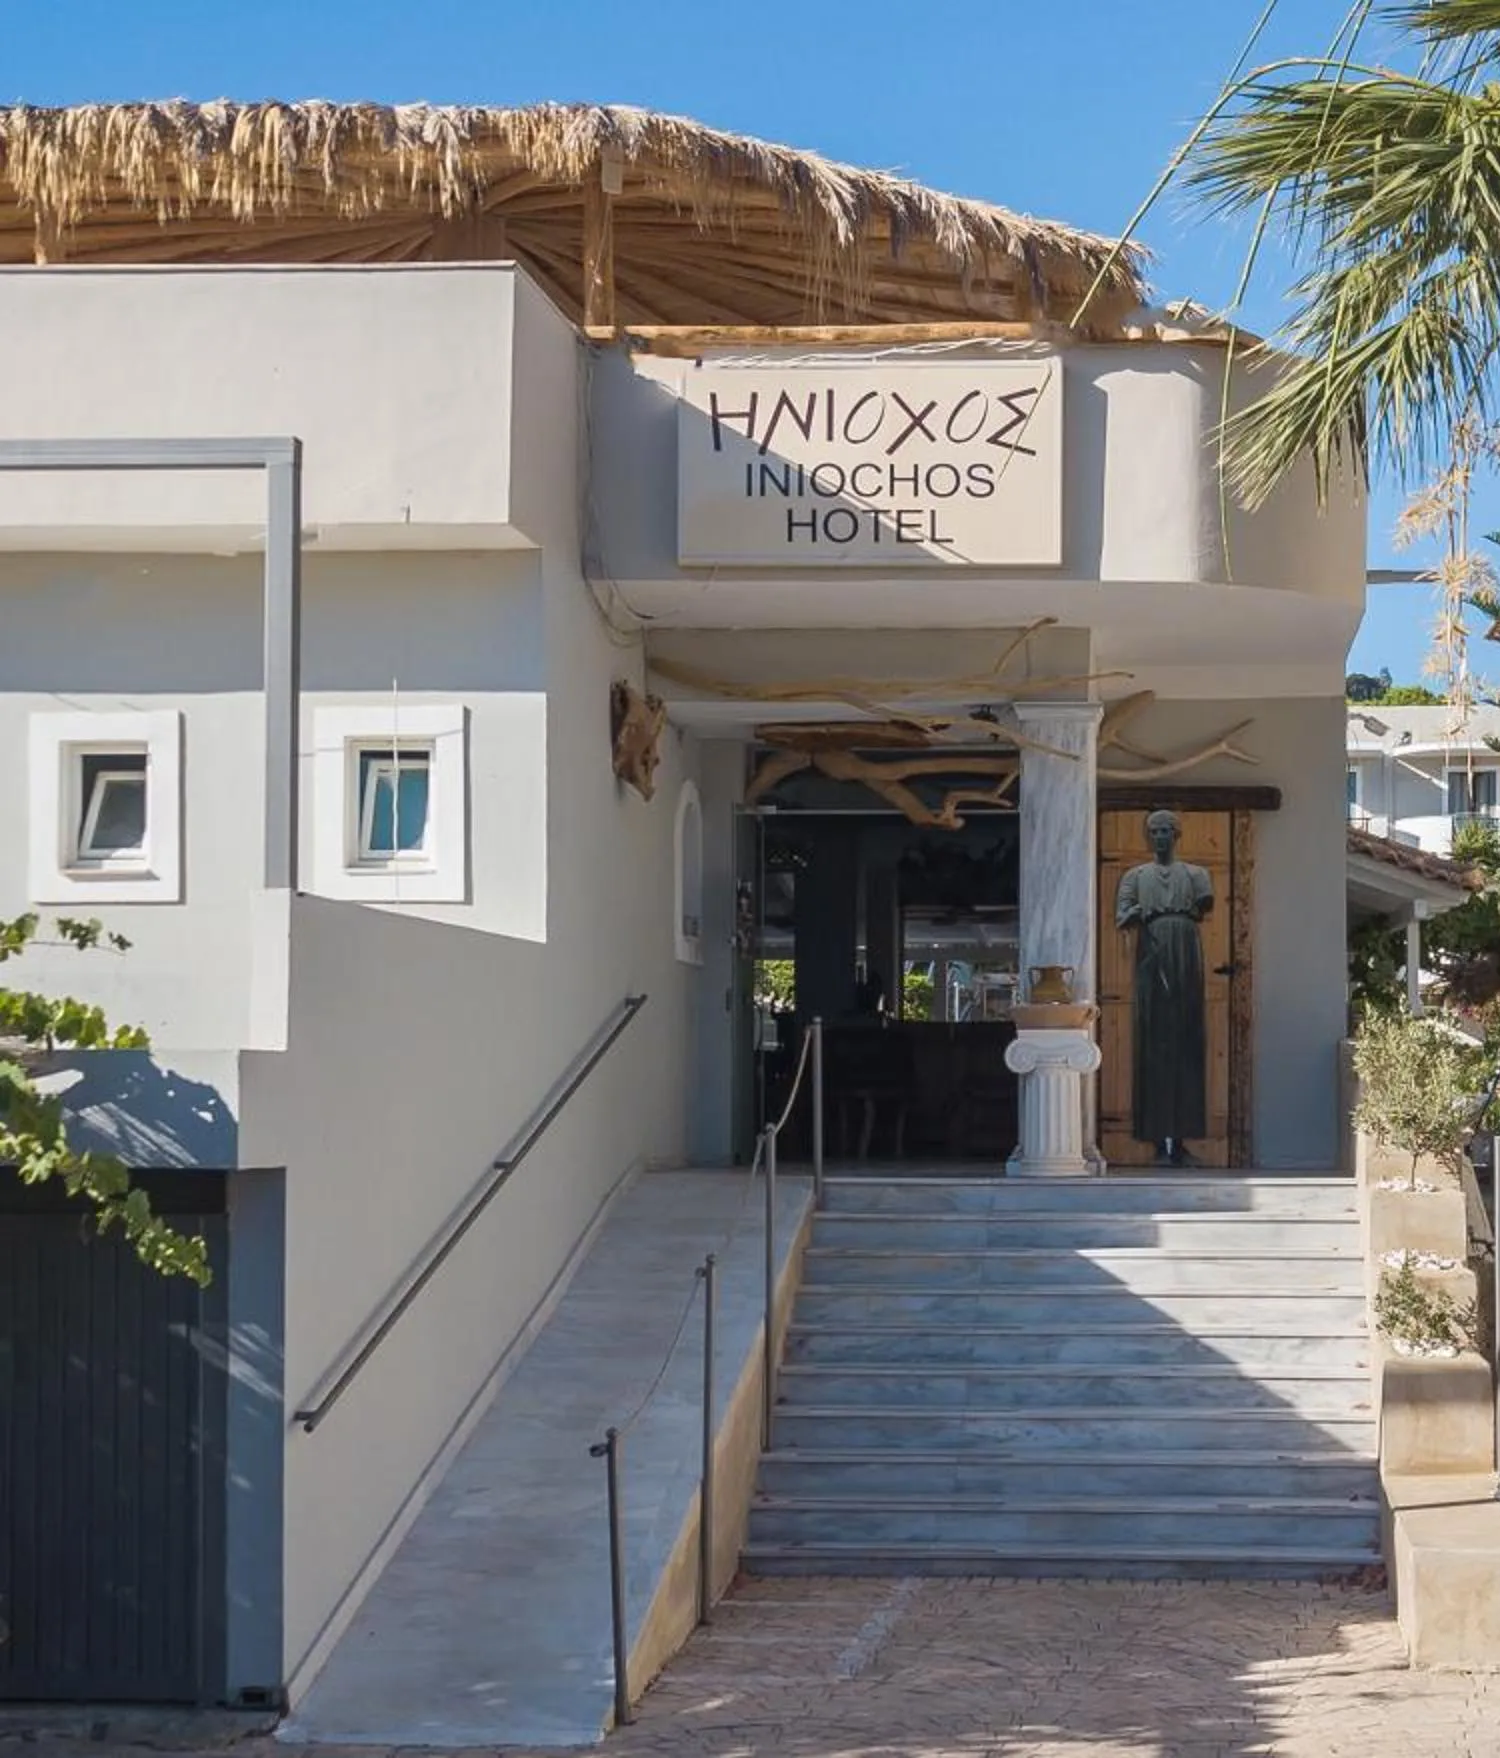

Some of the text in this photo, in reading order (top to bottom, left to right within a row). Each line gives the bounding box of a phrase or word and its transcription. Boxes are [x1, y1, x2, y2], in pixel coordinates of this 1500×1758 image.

[709, 387, 1038, 456] ΗΝΙΟΧΟΣ
[746, 463, 995, 498] INIOCHOS
[787, 508, 954, 544] HOTEL
